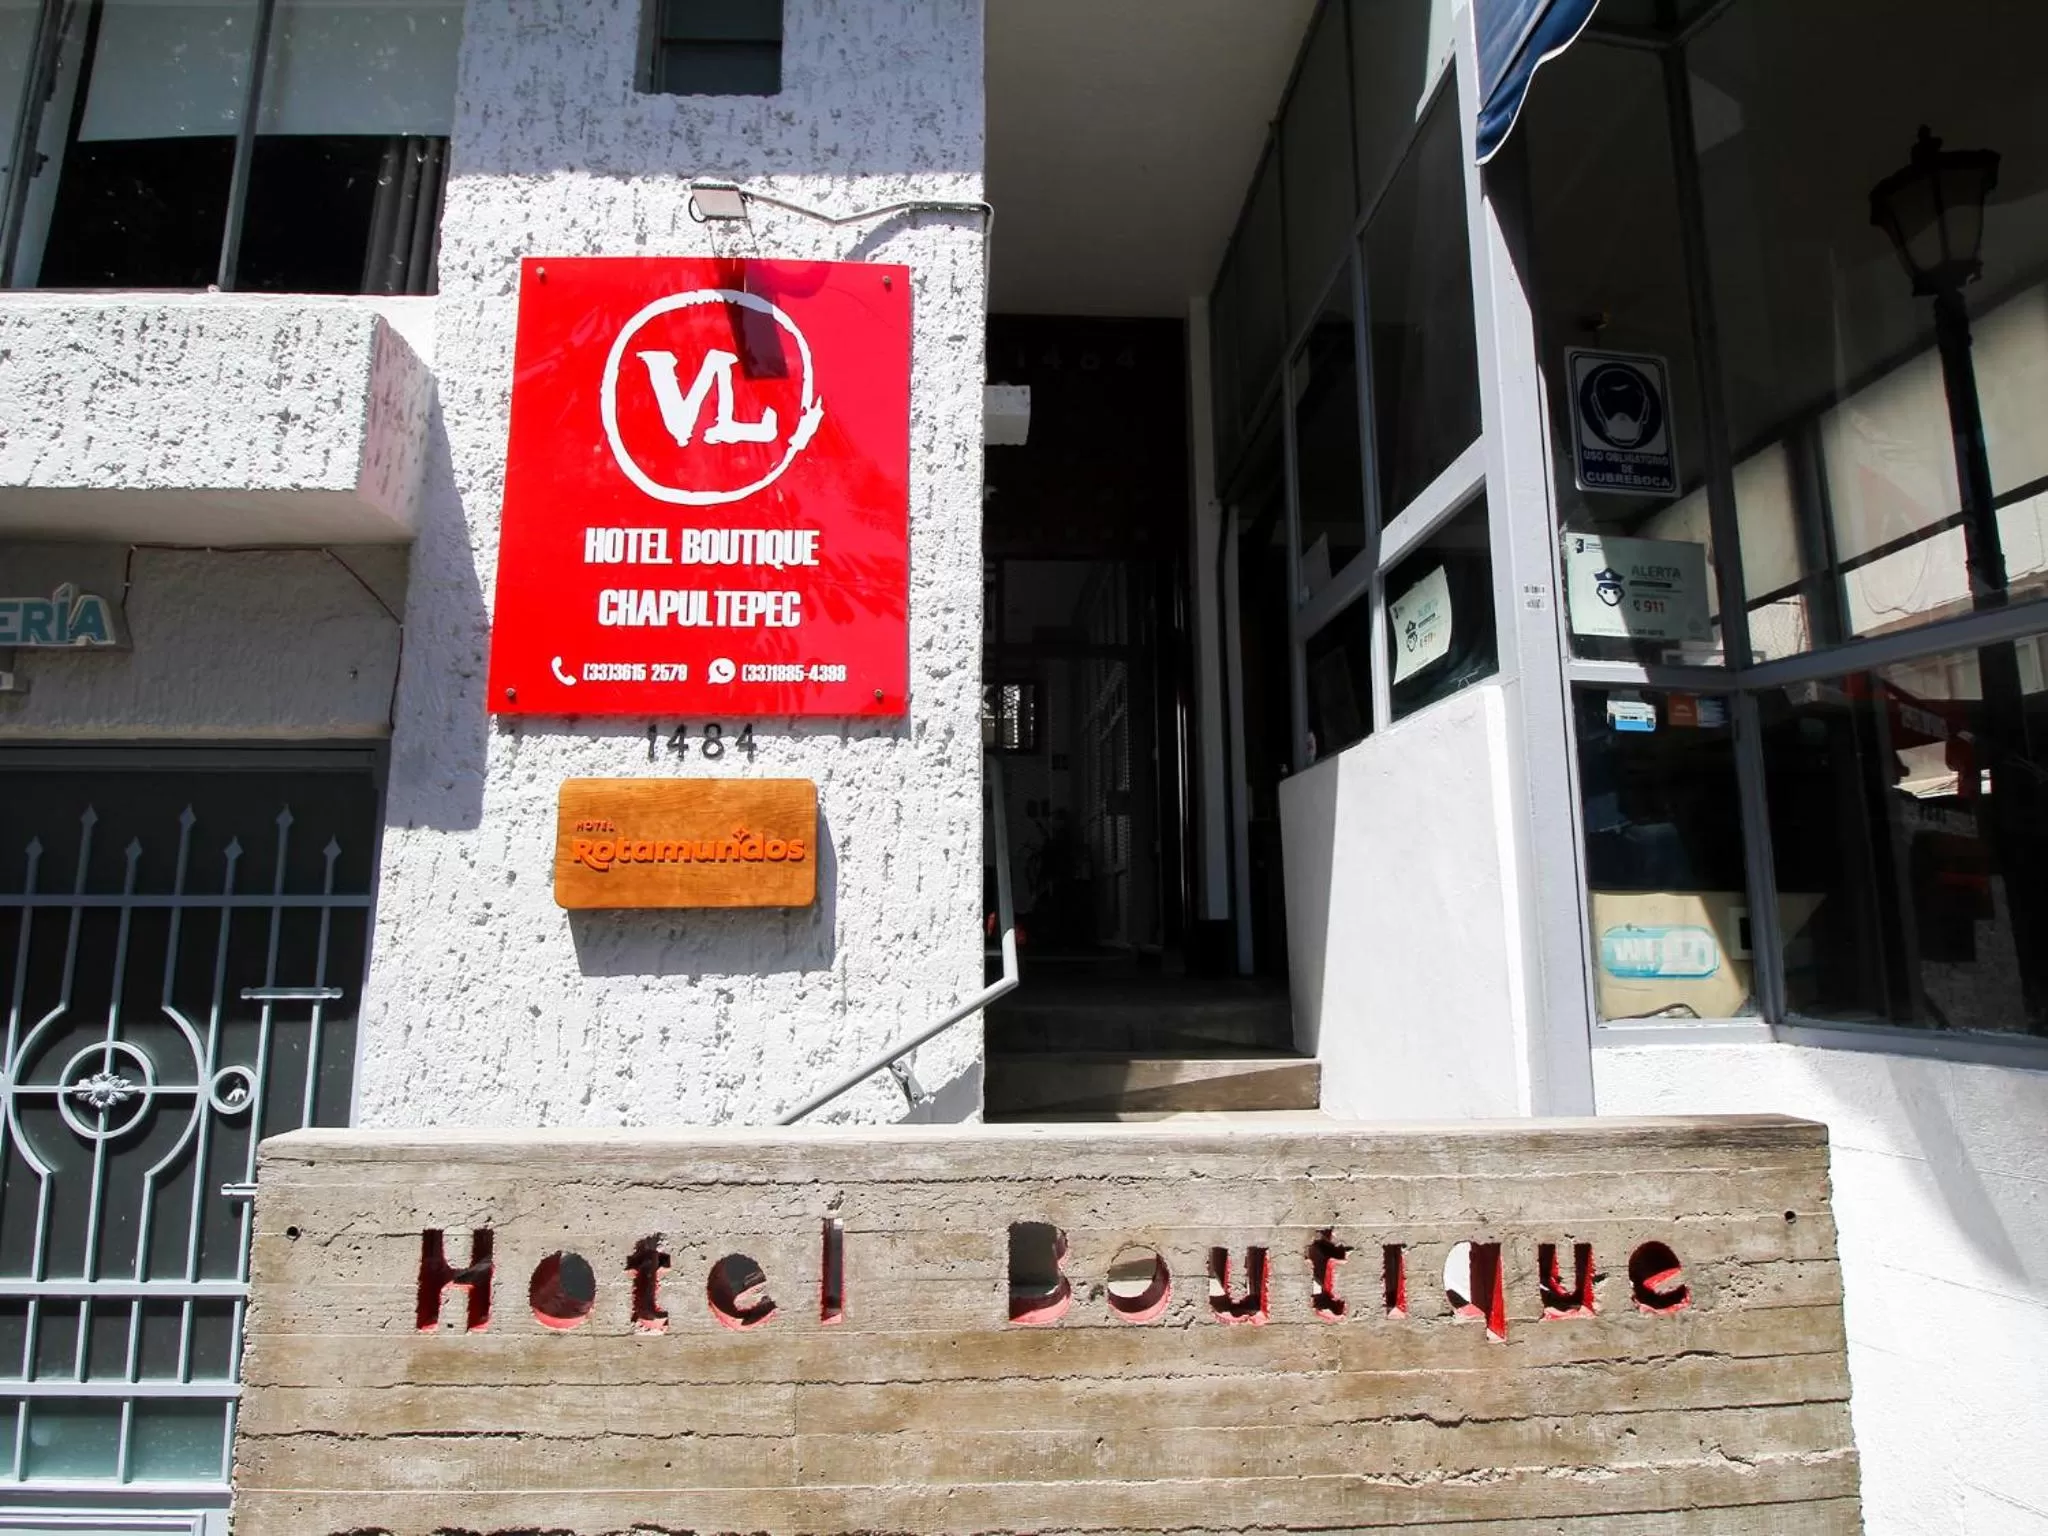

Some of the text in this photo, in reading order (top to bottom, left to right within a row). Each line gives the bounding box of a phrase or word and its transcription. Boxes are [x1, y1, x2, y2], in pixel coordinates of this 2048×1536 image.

[636, 349, 777, 446] VL
[1583, 450, 1604, 461] USO
[1621, 464, 1635, 473] DE
[1586, 472, 1670, 486] CUBREBOCA
[584, 528, 820, 571] HOTEL BOUTIQUE
[1631, 565, 1682, 580] ALERTA
[598, 589, 801, 628] CHAPULTEPEC
[1643, 601, 1665, 614] 911
[648, 722, 758, 762] 1484
[575, 819, 616, 832] HOTEL
[572, 832, 806, 872] Rotamundos
[416, 1217, 1693, 1343] Hotel Boutique
